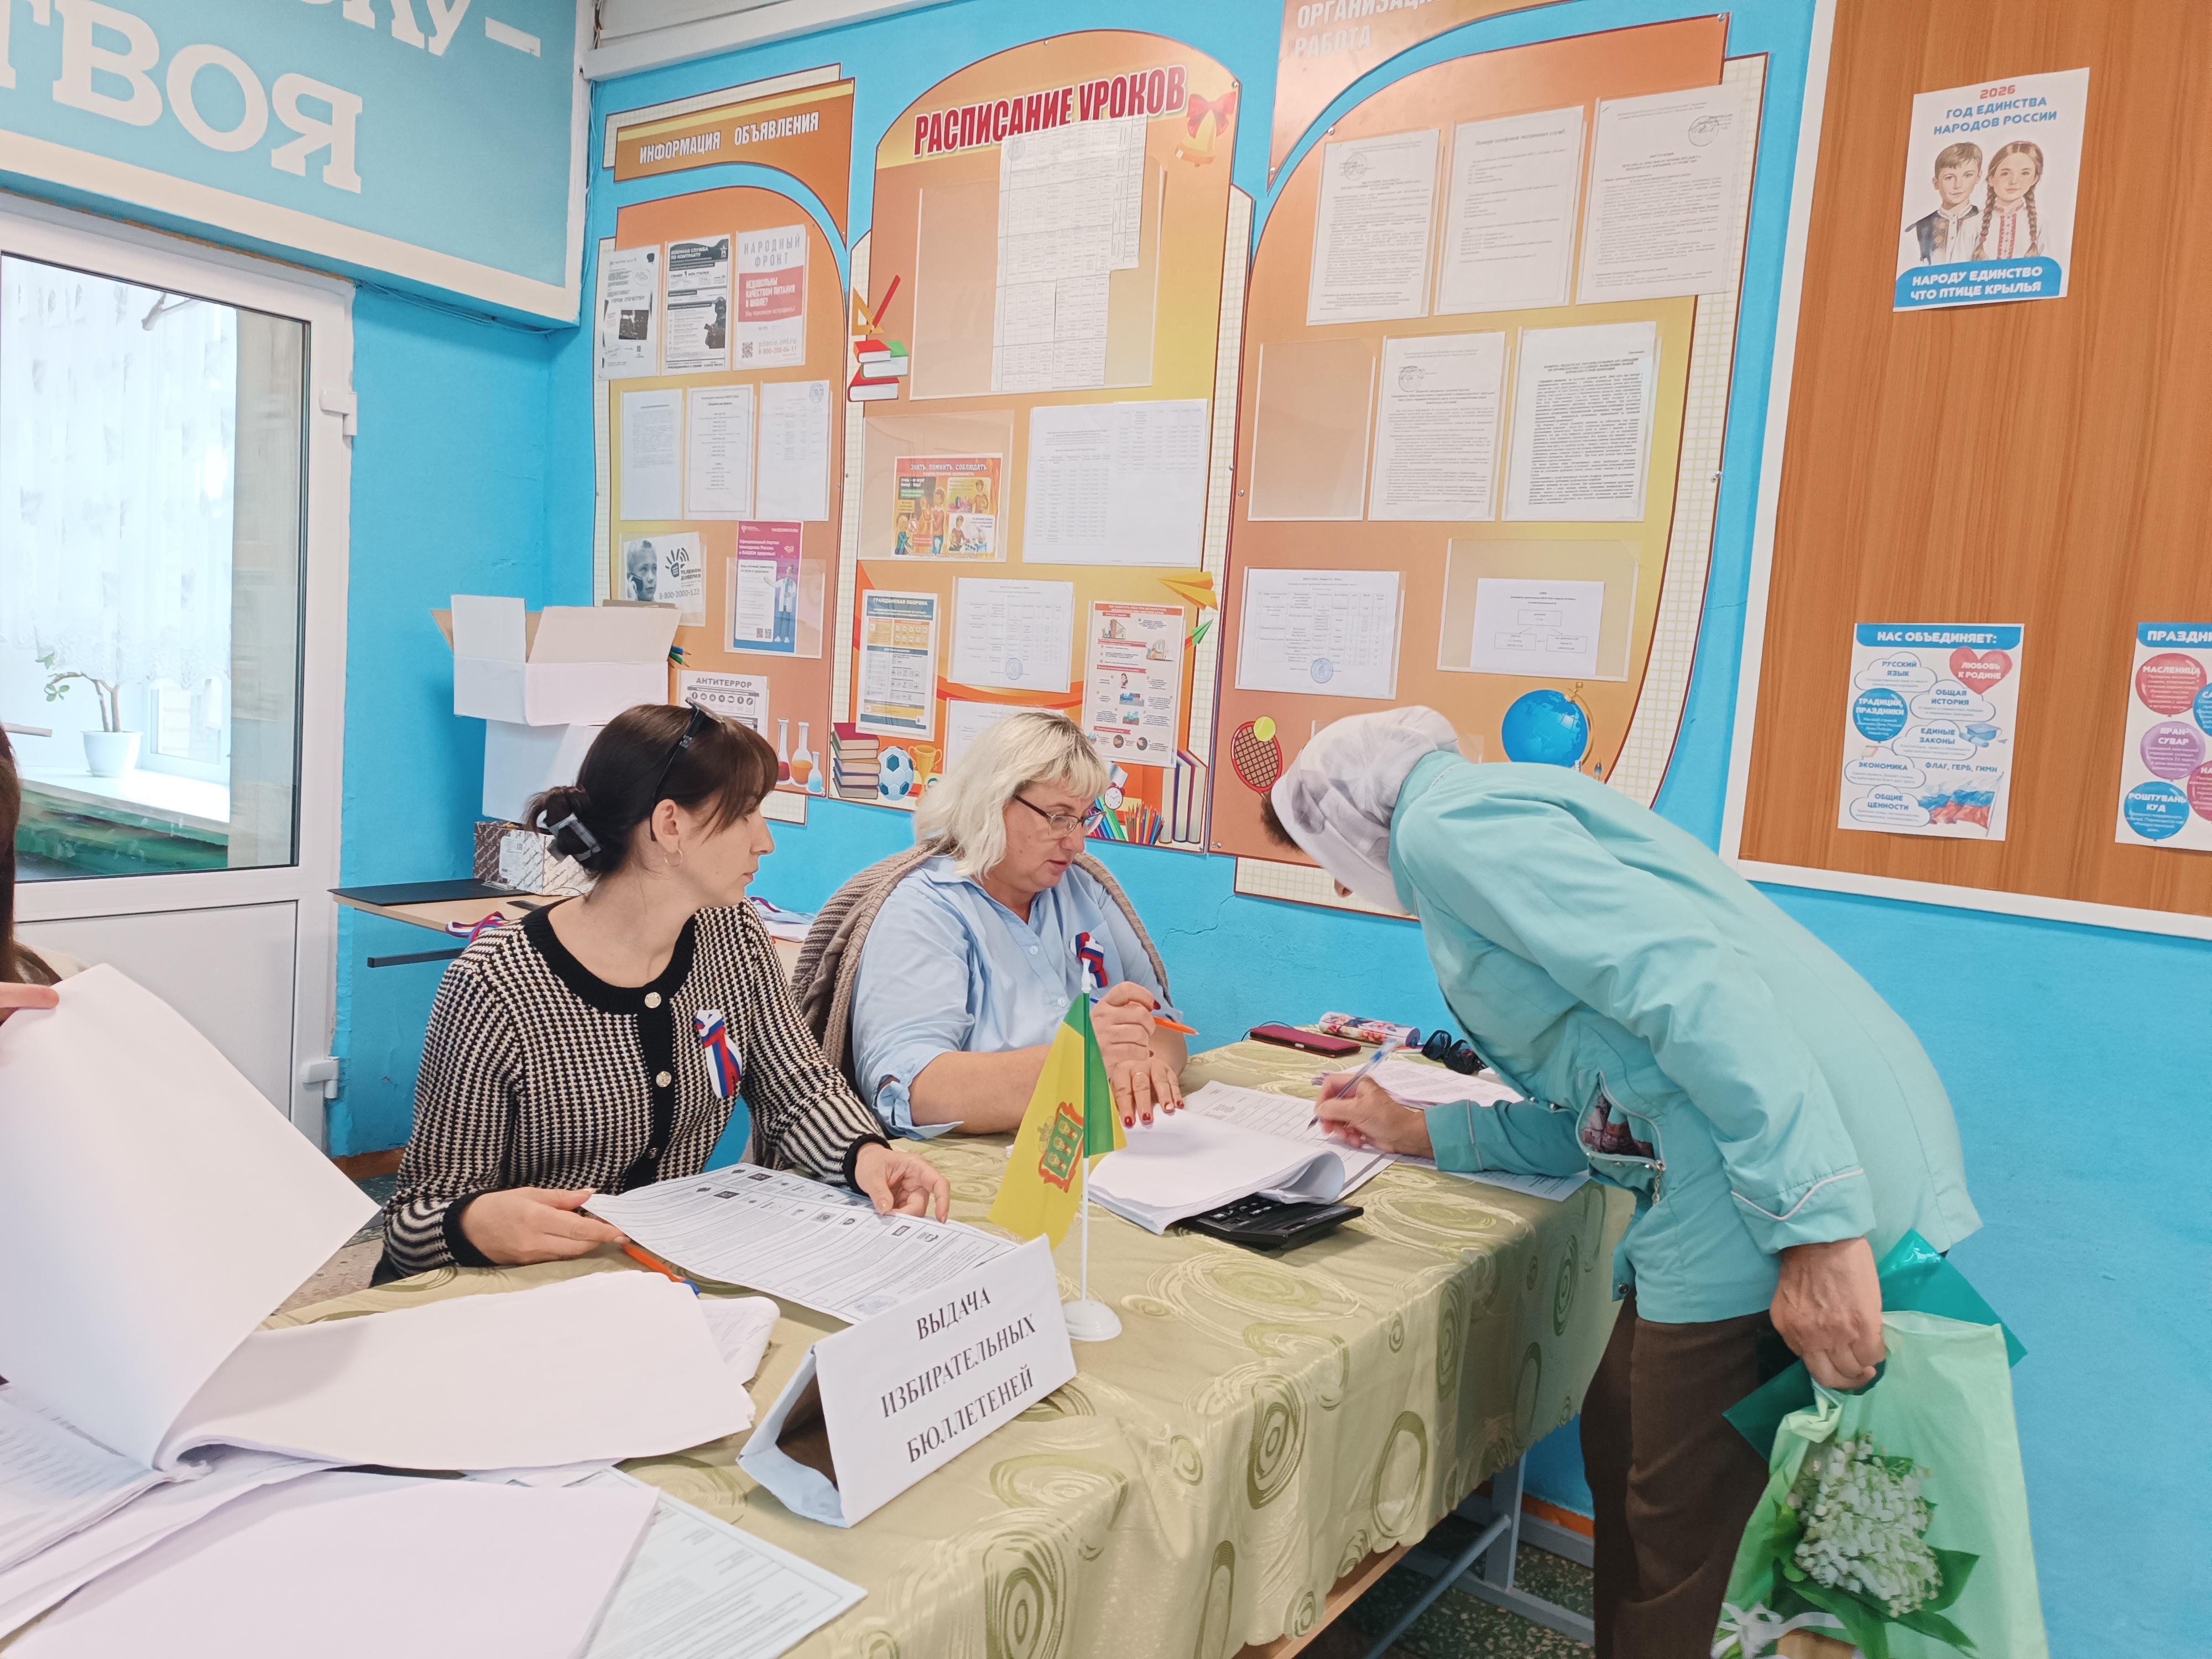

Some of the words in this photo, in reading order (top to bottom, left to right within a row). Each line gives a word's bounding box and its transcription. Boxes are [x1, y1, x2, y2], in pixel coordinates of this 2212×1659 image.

[1294, 25, 1371, 59] РАБОТА
[1980, 85, 2016, 99] 2026
[914, 87, 1073, 155] РАСПИСАНИЕ
[1078, 65, 1186, 122] УРОКОВ
[1946, 108, 1973, 119] ГОД
[1976, 97, 2047, 115] ЕДИНСТВА
[1934, 118, 2000, 135] НАРОДОВ
[2004, 111, 2057, 125] РОССИИ
[640, 132, 721, 164] ИНФОРМАЦИЯ
[734, 112, 819, 145] ОБЪЯВЛЕНИЯ
[744, 233, 800, 254] НАРОДНЫЙ
[755, 252, 788, 267] ФРОНТ
[746, 276, 778, 289] НЕДОВОЛЬНЫ
[1912, 271, 1966, 286] НАРОДУ
[1969, 266, 2043, 281] ЕДИНСТВО
[745, 288, 773, 298] КАЧЕСТВОМ
[774, 284, 795, 295] ПИТАНИЯ
[1911, 289, 1937, 300] ЧТО
[1939, 285, 1982, 299] ПТИЦЕ
[1985, 281, 2041, 295] КРЫЛЬЯ
[745, 299, 749, 308] В
[750, 298, 768, 307] ШКОЛЕ?
[759, 338, 796, 348] pitanie.onf.ru
[759, 346, 796, 354] 8-800-200-04-11
[659, 588, 700, 599] 8-800-2000-122
[1877, 631, 1902, 641] НАС
[1905, 632, 1997, 645] ОБЪЕДИНЯЕТ:
[1961, 661, 2000, 670] ЛЮБОВЬ
[2143, 666, 2200, 675] МАСЛЕНИЦА
[1966, 671, 2001, 680] РОДИНЕ
[696, 677, 752, 688] АНТИТЕРРОР
[1859, 698, 1903, 708] ТРАДИЦИИ,
[2158, 737, 2189, 745] СУВАР
[1859, 762, 1908, 770] ЭКОНОМИКА
[1925, 762, 1949, 771] ФЛАГ,
[1952, 764, 1973, 772] ГЕРБ,
[2128, 792, 2187, 804] РОШТУВАНЬ
[1867, 802, 1909, 810] ЦЕННОСТИ
[2146, 804, 2166, 813] КУД
[916, 1287, 992, 1341] ВЫДАЧА
[880, 1313, 1036, 1419] ИЗБИРАТЕЛЬНЫХ
[906, 1364, 1035, 1464] БЮЛЛЕТЕНЕЙ
